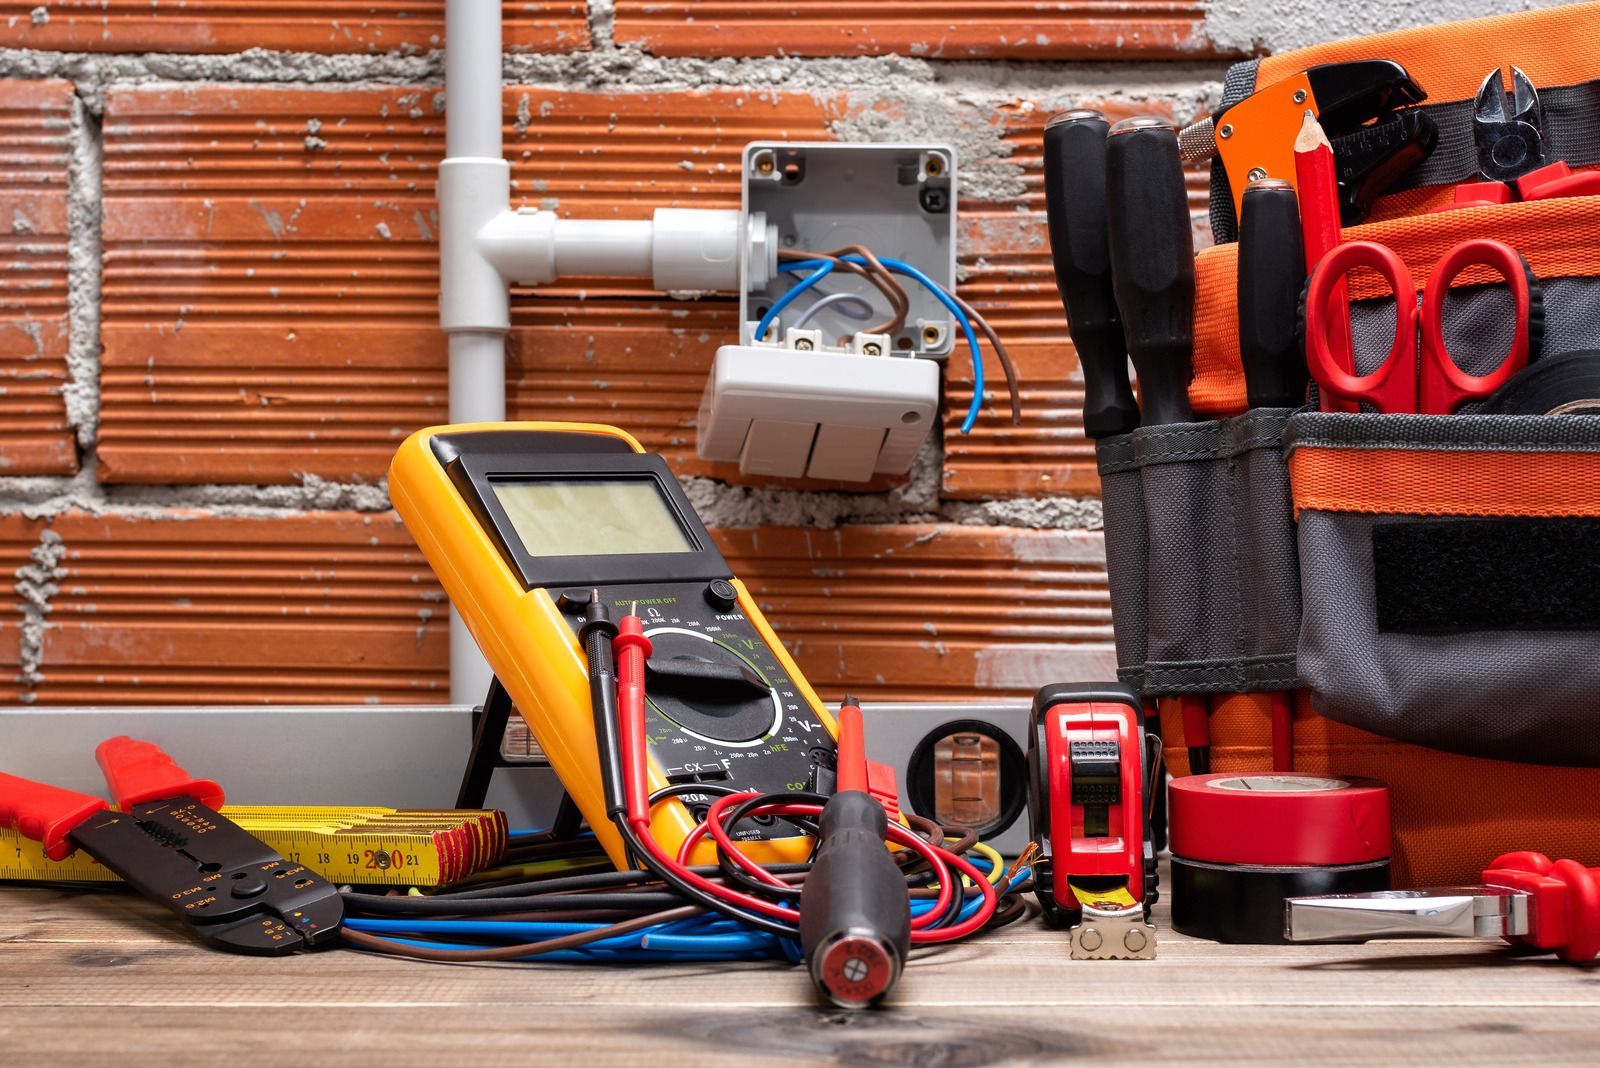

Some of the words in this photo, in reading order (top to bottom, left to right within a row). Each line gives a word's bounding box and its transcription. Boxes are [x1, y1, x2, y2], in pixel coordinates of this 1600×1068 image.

[769, 743, 789, 753] hFE
[684, 762, 703, 772] CX
[720, 758, 731, 769] F
[786, 781, 806, 791] CO
[682, 793, 709, 803] 20A
[15, 848, 21, 858] 7
[289, 853, 301, 863] 17
[318, 853, 330, 864] 18
[347, 853, 359, 864] 19
[364, 850, 404, 870] 20
[406, 854, 420, 865] 21
[260, 861, 280, 871] M4
[202, 873, 223, 882] M5
[172, 885, 203, 899] M3.0
